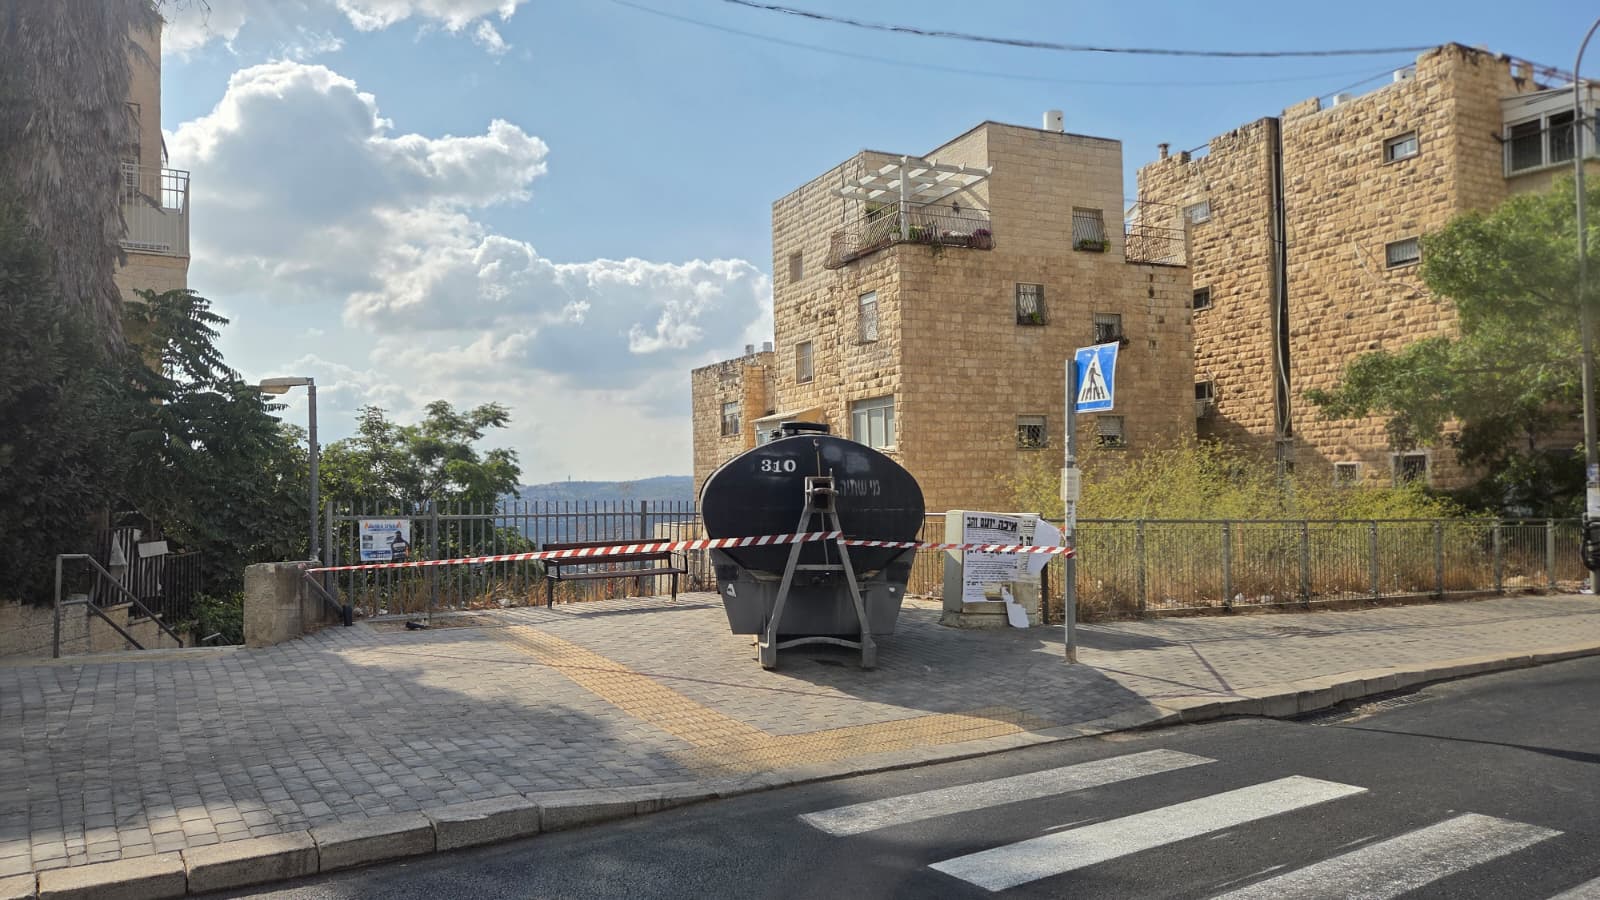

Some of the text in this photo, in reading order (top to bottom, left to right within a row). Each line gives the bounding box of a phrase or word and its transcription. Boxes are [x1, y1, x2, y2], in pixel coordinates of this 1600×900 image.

[761, 459, 796, 473] 310
[869, 479, 880, 496] מי
[998, 519, 1018, 531] איכה
